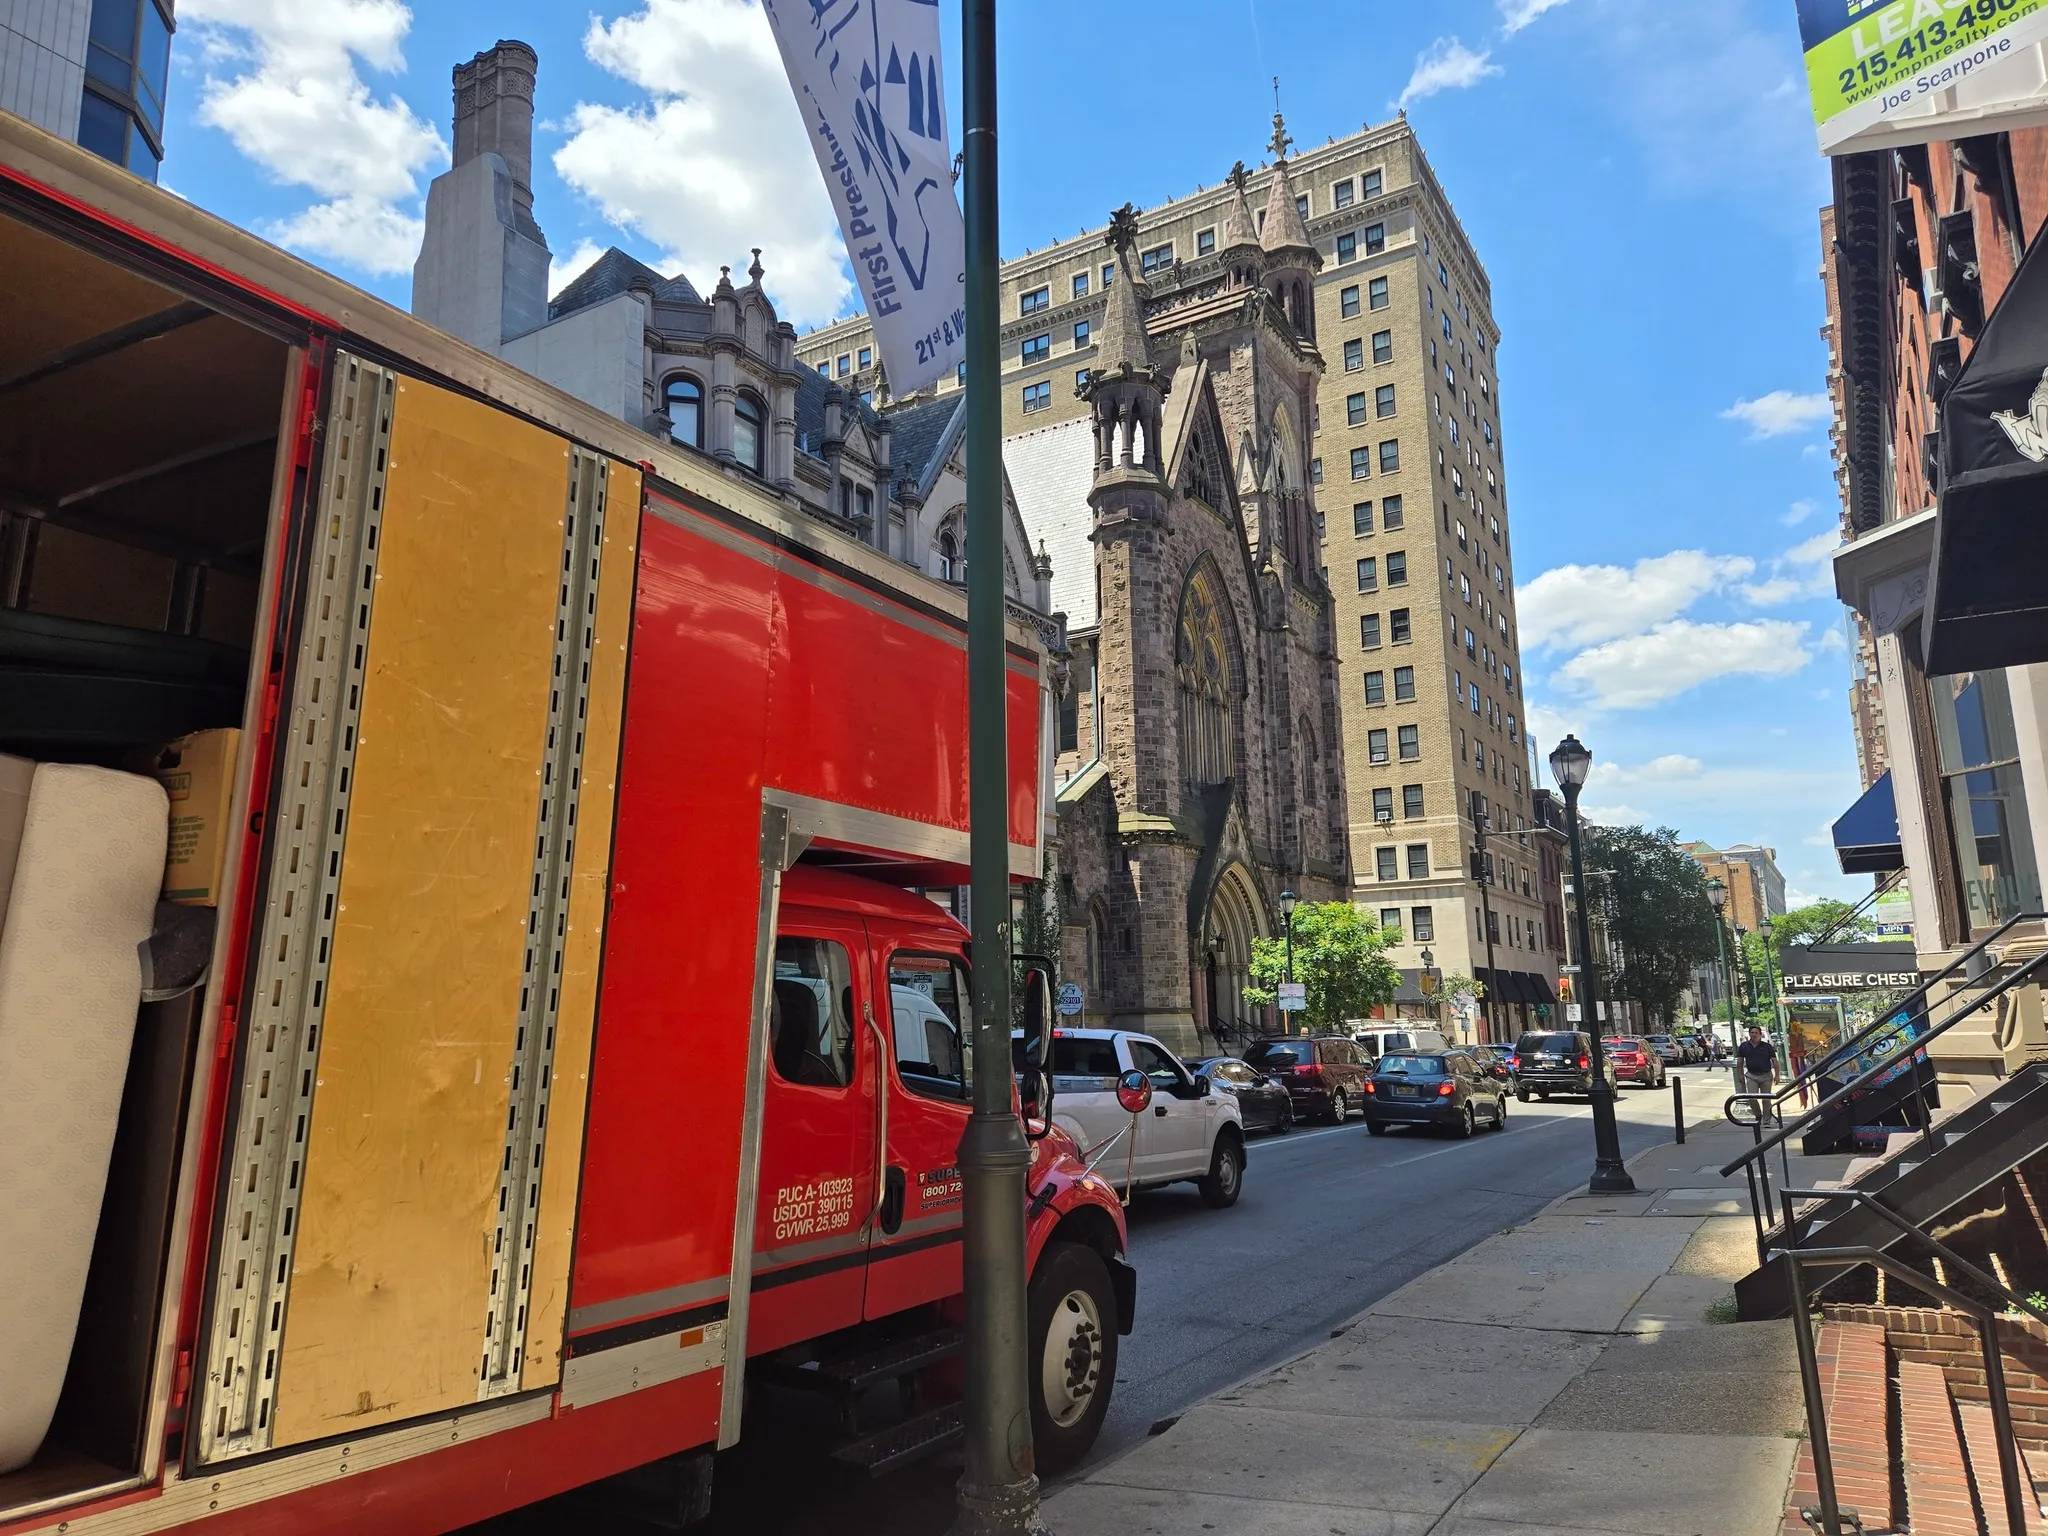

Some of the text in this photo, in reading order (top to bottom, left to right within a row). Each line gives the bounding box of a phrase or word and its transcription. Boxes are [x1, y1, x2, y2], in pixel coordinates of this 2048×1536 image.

[1838, 0, 2022, 94] 215.413.490
[1846, 2, 2038, 104] www.mpnrealty.com
[1881, 38, 2011, 113] Joe Scarpone
[859, 242, 902, 317] First
[915, 327, 941, 365] 21st
[943, 321, 955, 347] &
[1783, 972, 1918, 988] PLEASURE CHEST
[773, 1194, 853, 1223] USDOT 390115
[777, 1177, 853, 1205] PUC A-103923
[922, 1184, 947, 1200] (800)
[775, 1211, 850, 1240] GVWR 25,999
